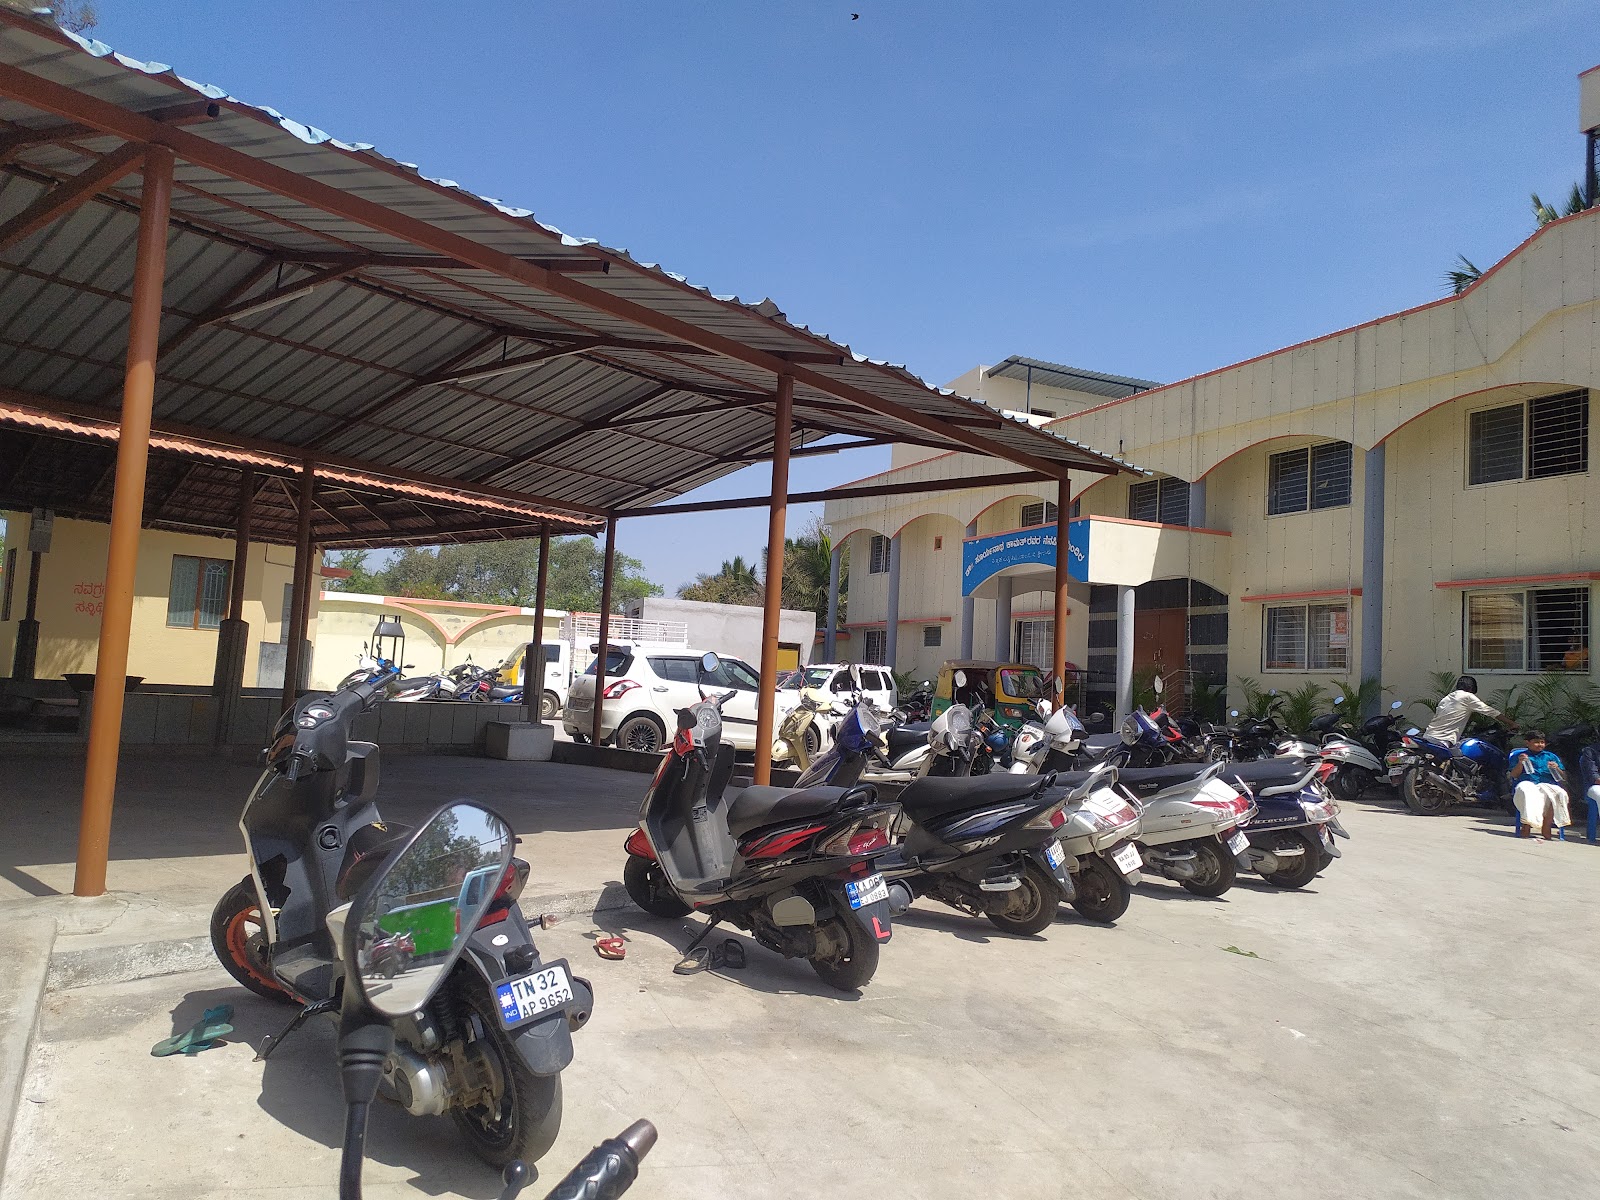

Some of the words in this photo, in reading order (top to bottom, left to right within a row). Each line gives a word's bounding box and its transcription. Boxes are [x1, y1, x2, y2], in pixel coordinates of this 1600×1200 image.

[73, 581, 105, 599] ನವಗ್ರ
[855, 882, 867, 894] KA
[868, 877, 880, 889] 06
[513, 978, 536, 1000] TN
[537, 970, 559, 991] 32
[522, 1000, 537, 1017] AP
[539, 988, 571, 1010] 9652
[504, 1009, 518, 1019] IND
